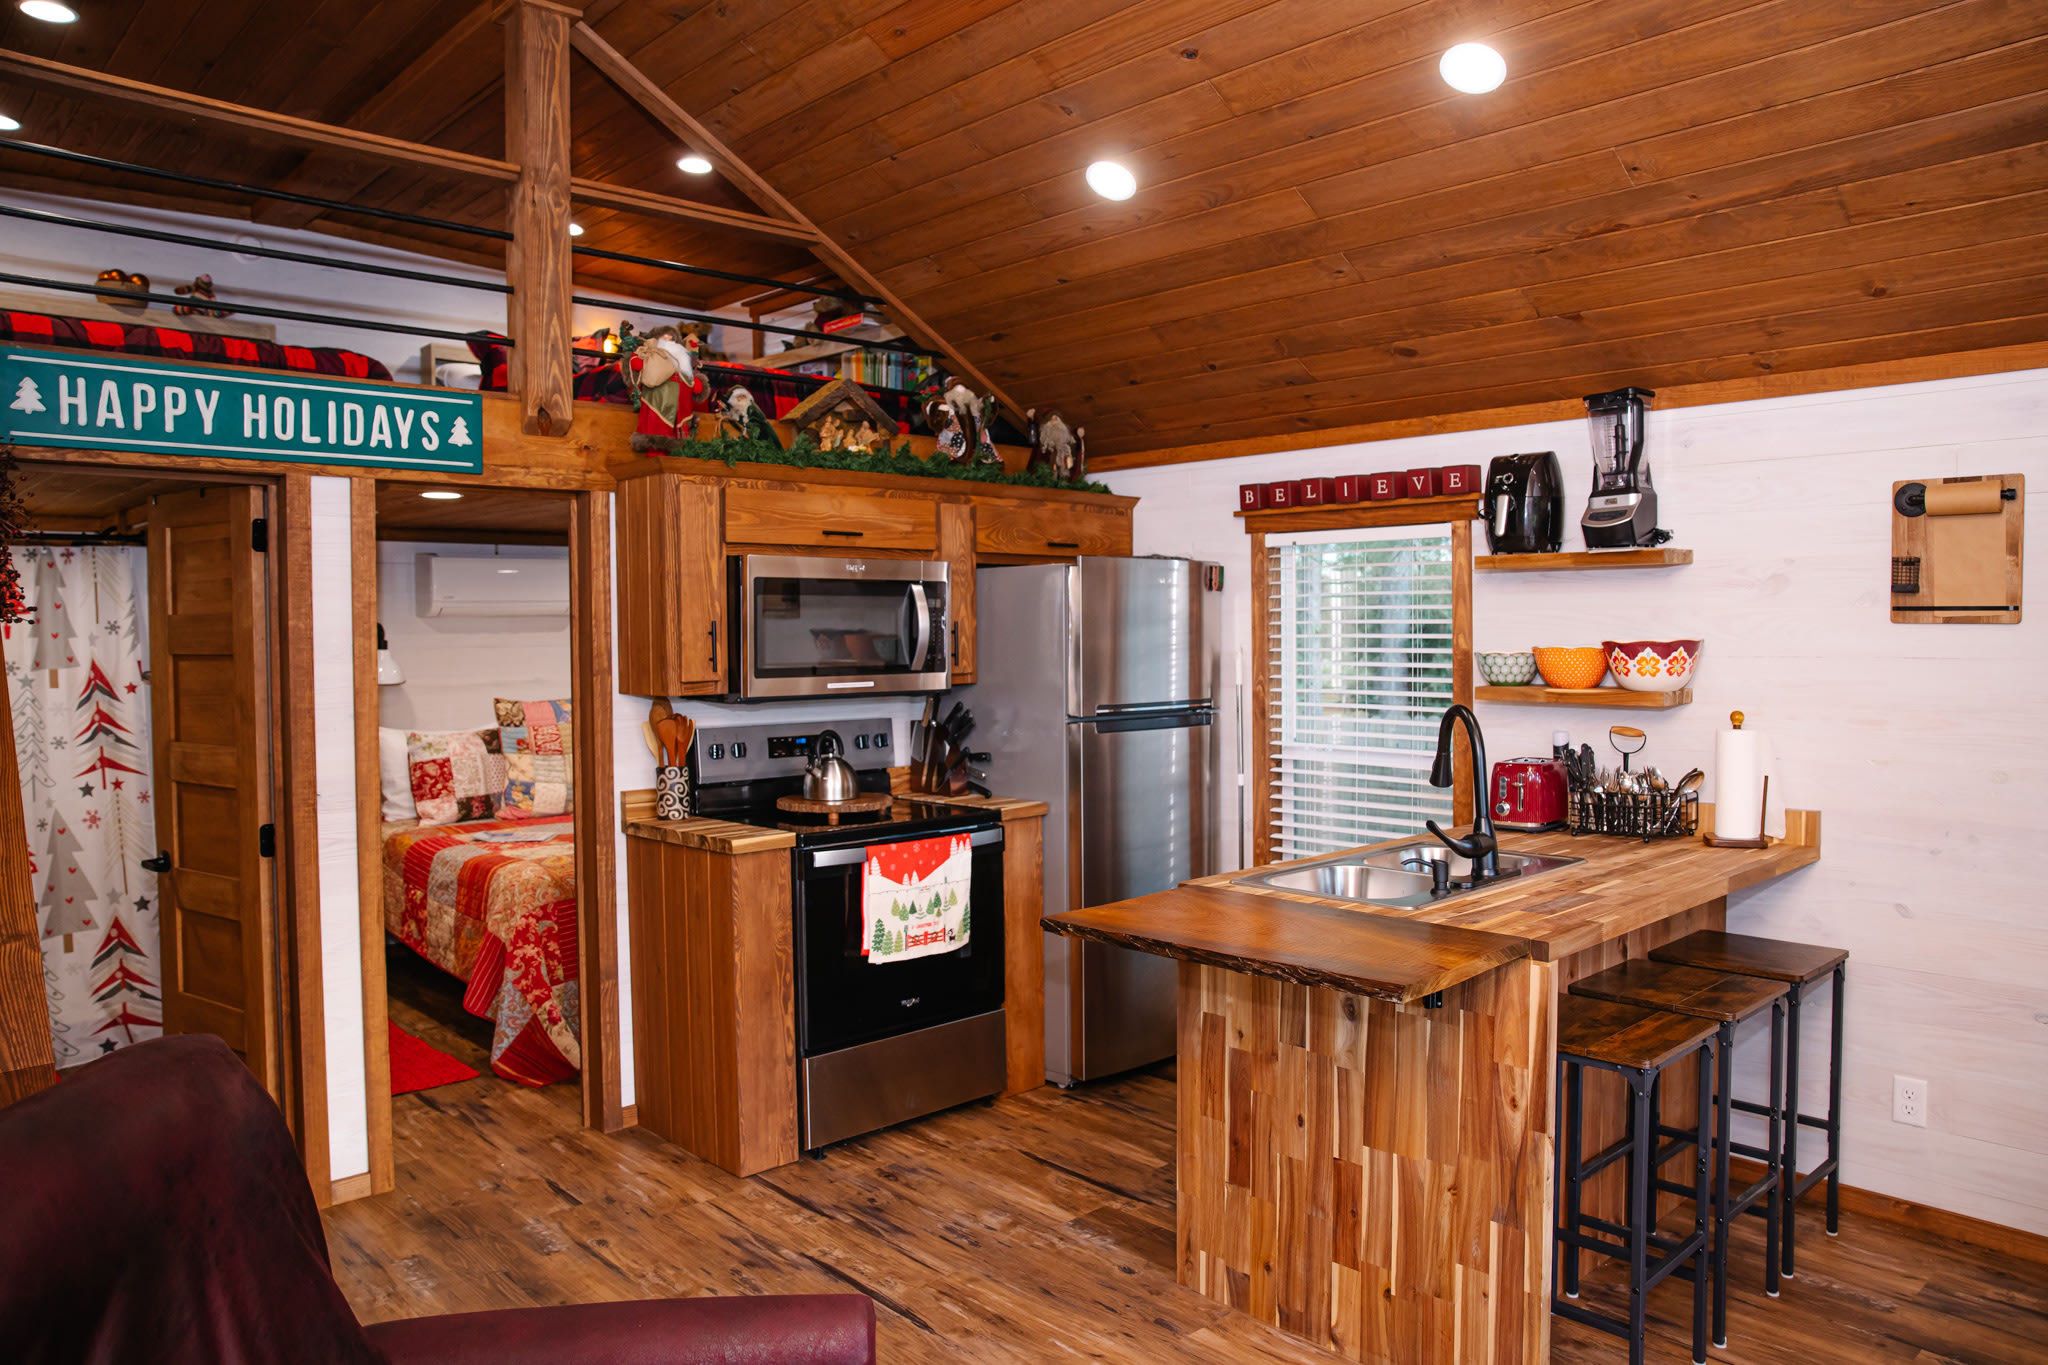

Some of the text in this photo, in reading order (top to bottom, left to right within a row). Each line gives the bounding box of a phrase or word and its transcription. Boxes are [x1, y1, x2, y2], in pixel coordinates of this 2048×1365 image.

[58, 374, 440, 452] HAPPY HOLIDAYS
[1244, 472, 1462, 504] BELIEVE
